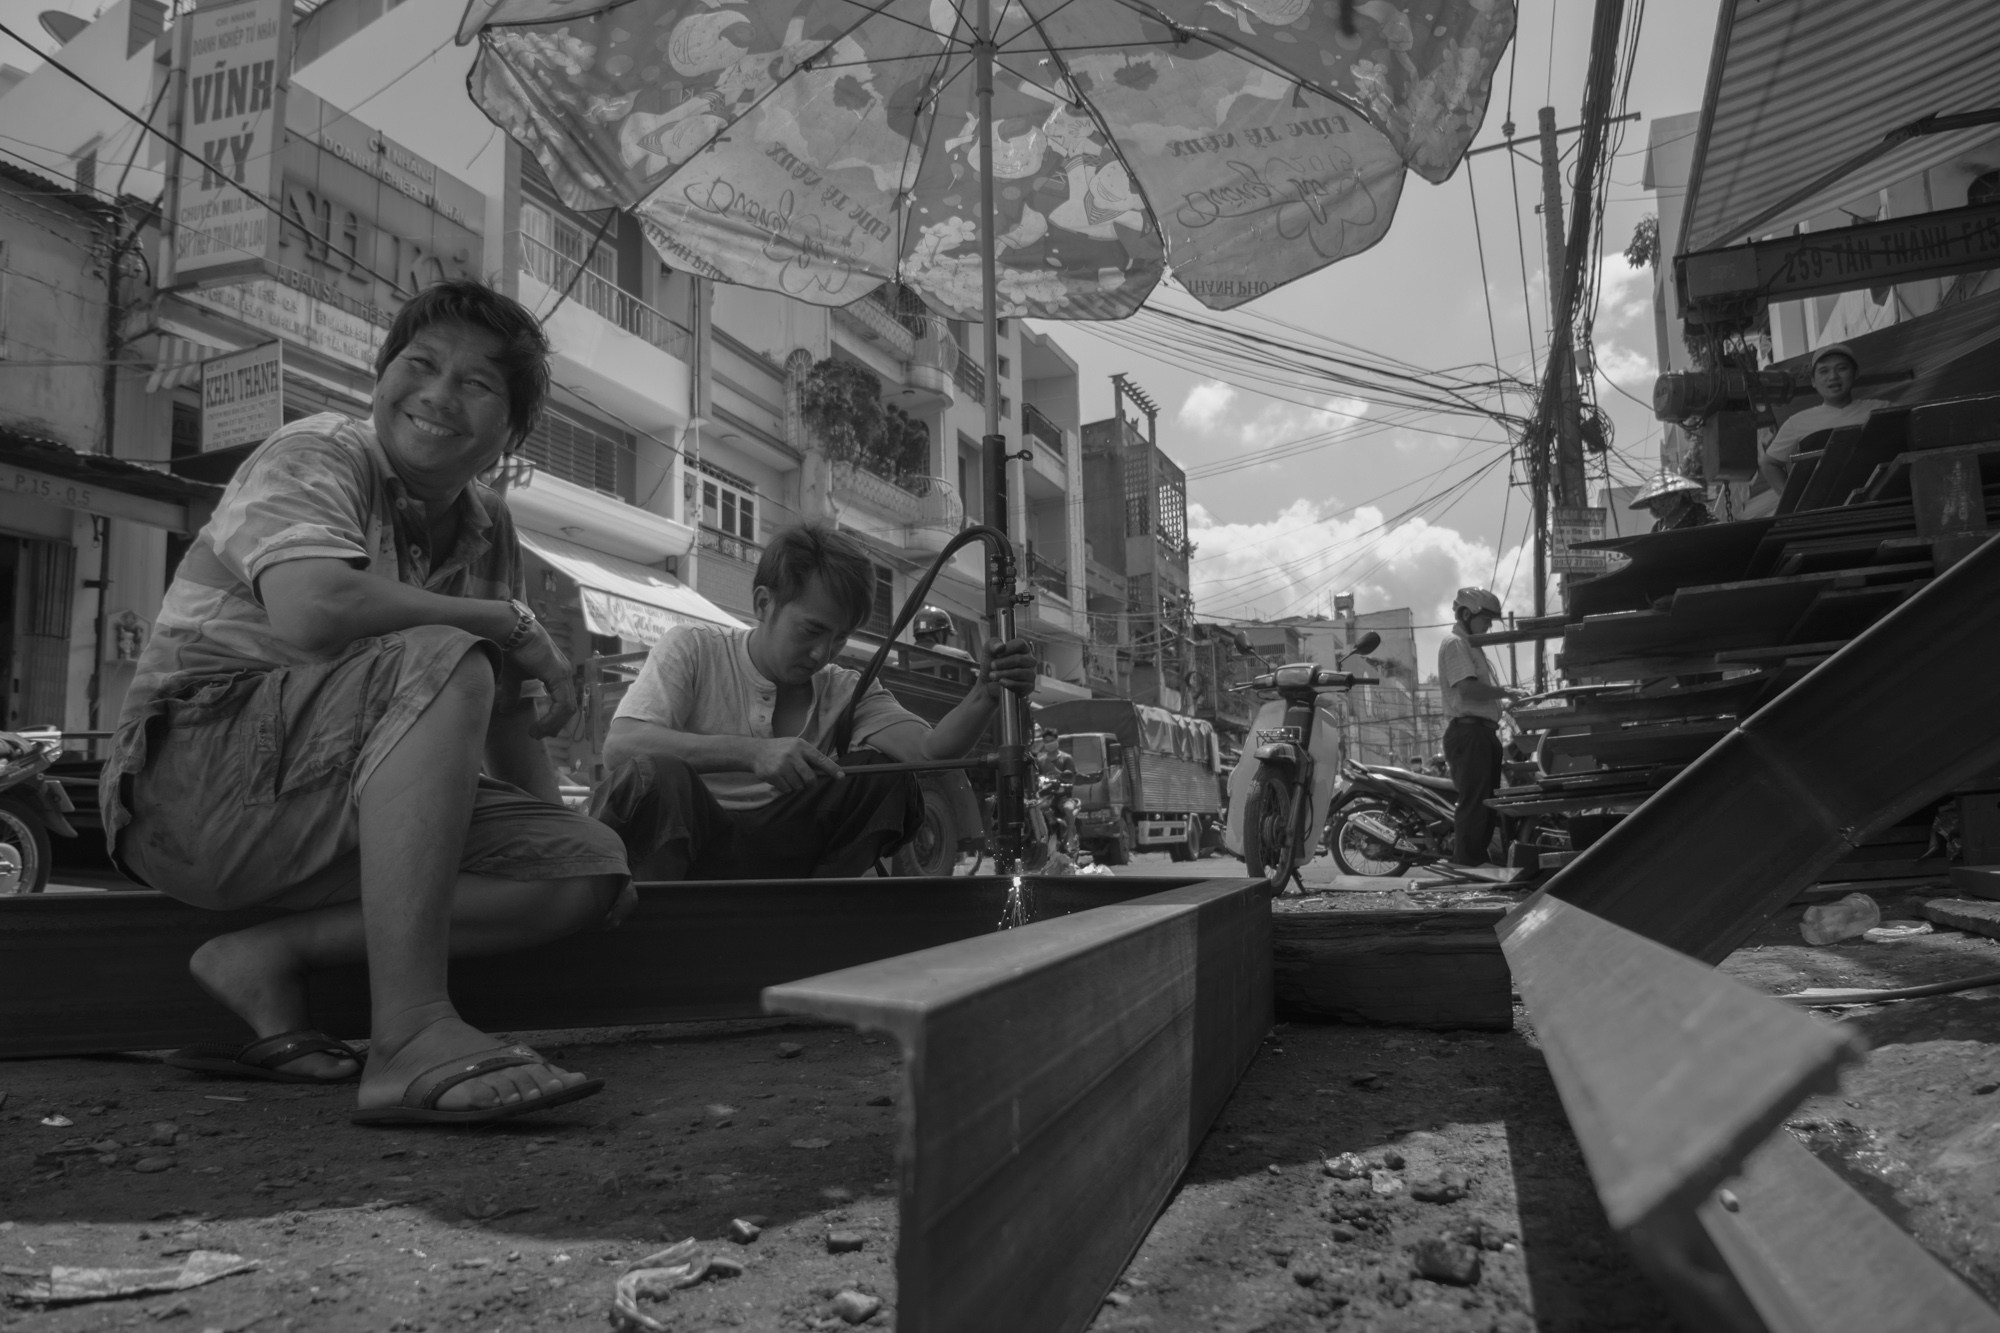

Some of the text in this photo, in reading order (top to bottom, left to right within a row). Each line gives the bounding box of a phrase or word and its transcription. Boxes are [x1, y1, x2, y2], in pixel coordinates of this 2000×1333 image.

[192, 60, 275, 125] VĨNH
[201, 122, 254, 191] KÝ
[323, 136, 373, 170] DOANH
[1880, 225, 1950, 266] THÀNH
[15, 474, 50, 496] P.15
